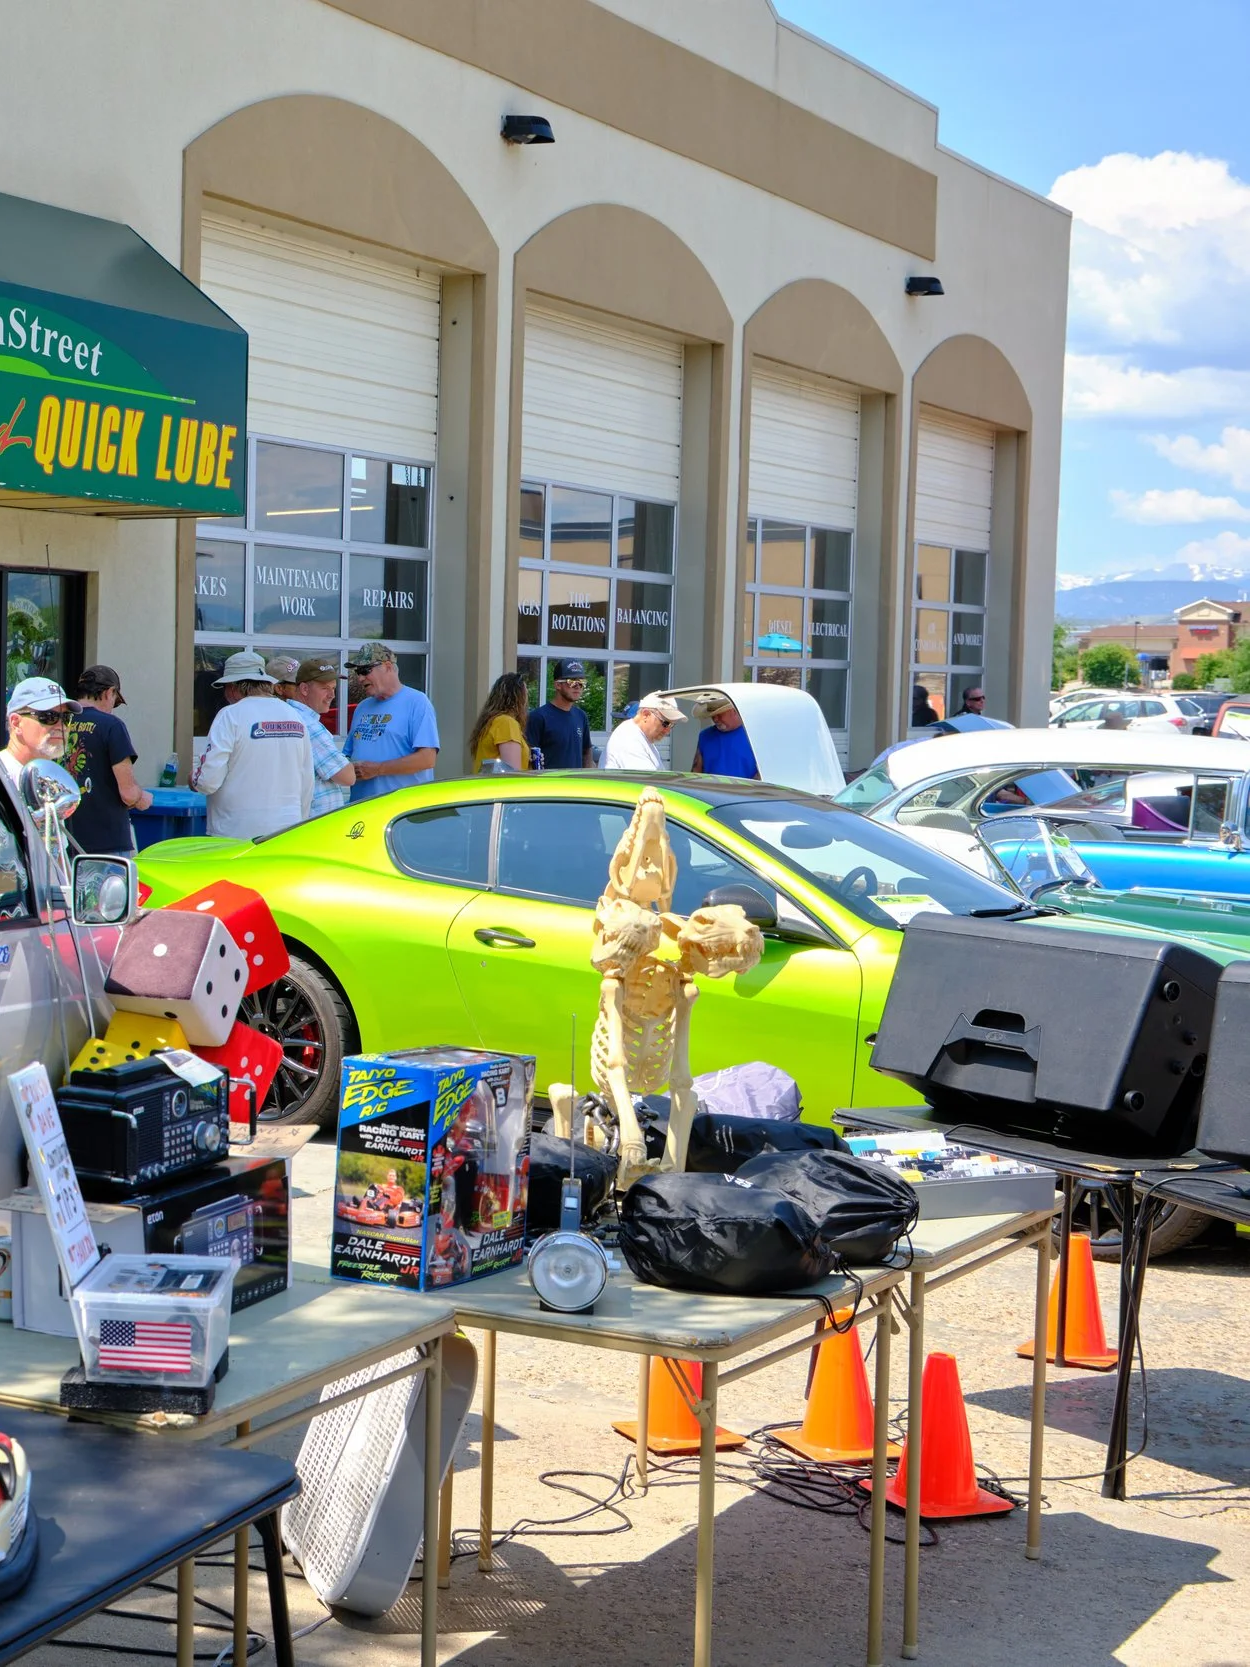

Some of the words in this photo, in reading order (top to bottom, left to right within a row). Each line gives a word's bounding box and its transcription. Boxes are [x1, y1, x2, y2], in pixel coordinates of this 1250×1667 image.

[34, 395, 144, 476] QUICK
[155, 415, 237, 489] LUBE
[256, 566, 339, 591] MAINTENANCE
[280, 596, 316, 616] WORK
[363, 588, 414, 609] REPAIRS
[568, 592, 591, 609] TIRE
[551, 614, 606, 633] ROTATIONS
[617, 608, 668, 627] BALANCING
[808, 622, 848, 637] ELECTRICAL
[953, 633, 964, 645] AND
[966, 634, 983, 646] MORE!
[349, 1068, 396, 1084] TAIYO
[437, 1068, 465, 1095] TAIYO
[342, 1079, 416, 1110] EDGE
[432, 1077, 475, 1126] EDGE
[495, 1088, 506, 1106] 8
[359, 1101, 388, 1119] R/C
[359, 1124, 397, 1137] RACING
[399, 1129, 426, 1141] KART
[381, 1123, 399, 1131] Radio
[400, 1125, 425, 1133] Control
[359, 1133, 374, 1141] with
[374, 1136, 400, 1146] DALE
[365, 1141, 425, 1157] EARNHARDT
[411, 1153, 425, 1162] JR
[348, 1236, 385, 1250] DALE
[356, 1229, 385, 1239] NASCAR
[386, 1234, 420, 1244] SuperStar
[482, 1229, 505, 1245] DALE
[334, 1245, 420, 1268] EARNHARDT
[472, 1237, 524, 1262] EARNHARDT
[511, 1248, 523, 1263] JR
[400, 1265, 419, 1278] JR
